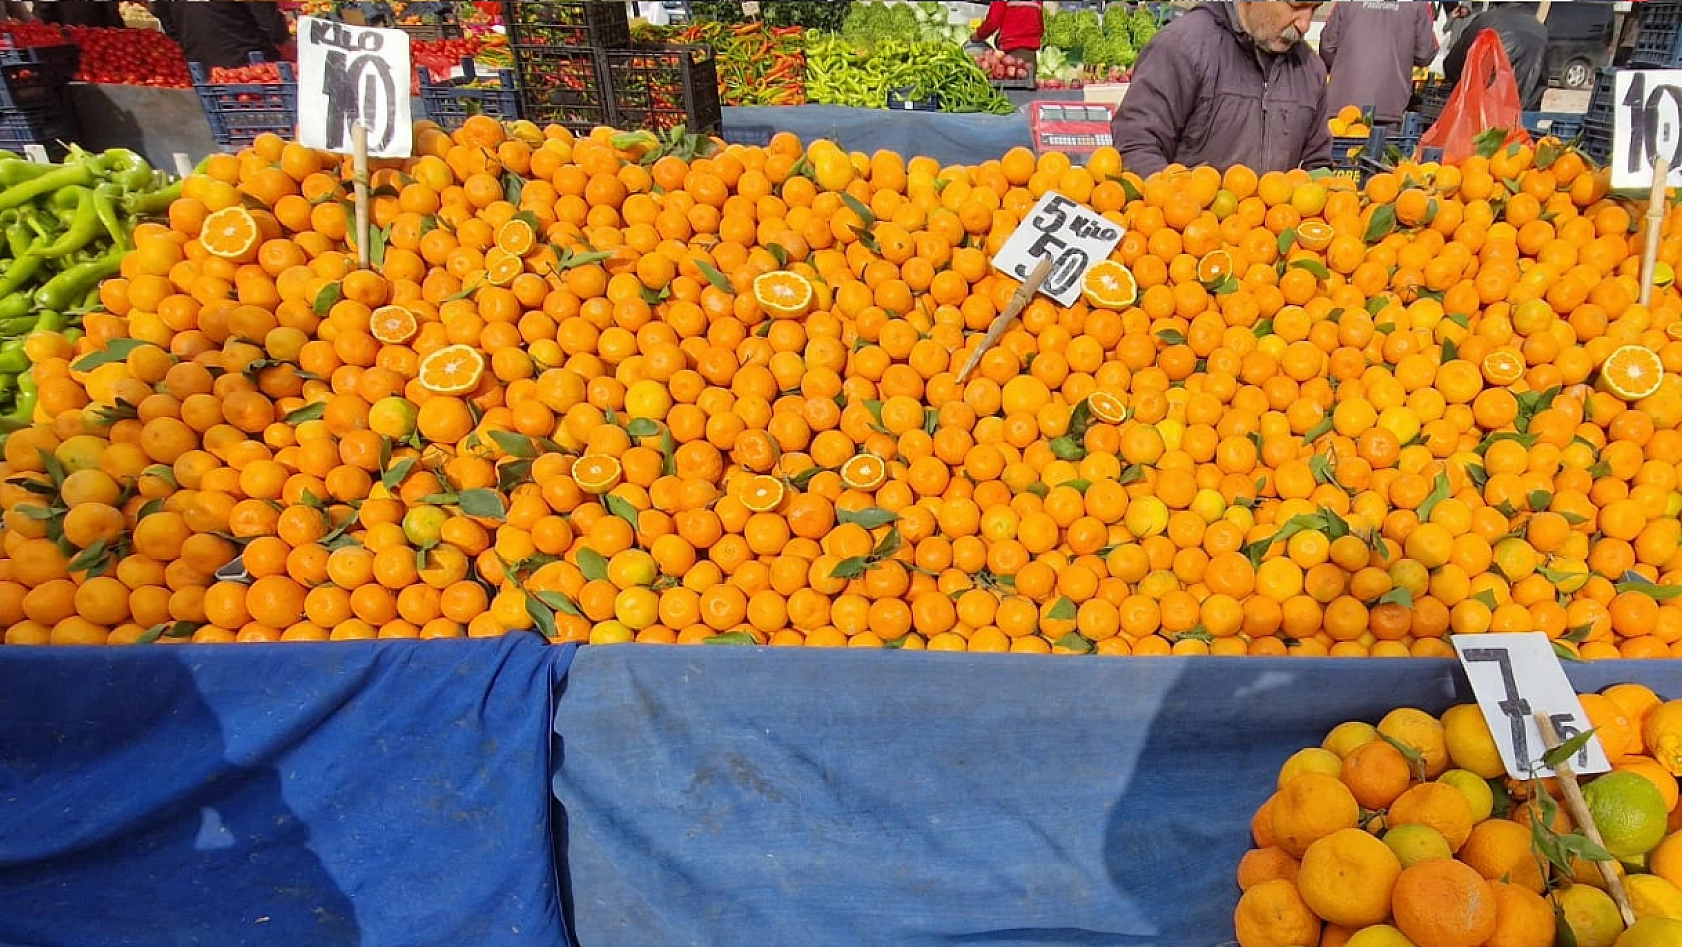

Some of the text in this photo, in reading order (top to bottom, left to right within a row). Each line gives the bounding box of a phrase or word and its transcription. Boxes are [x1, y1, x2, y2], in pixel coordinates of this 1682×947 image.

[322, 50, 396, 152] 10
[1622, 72, 1682, 173] 10
[1032, 195, 1077, 233] 5
[1014, 233, 1089, 296] 50
